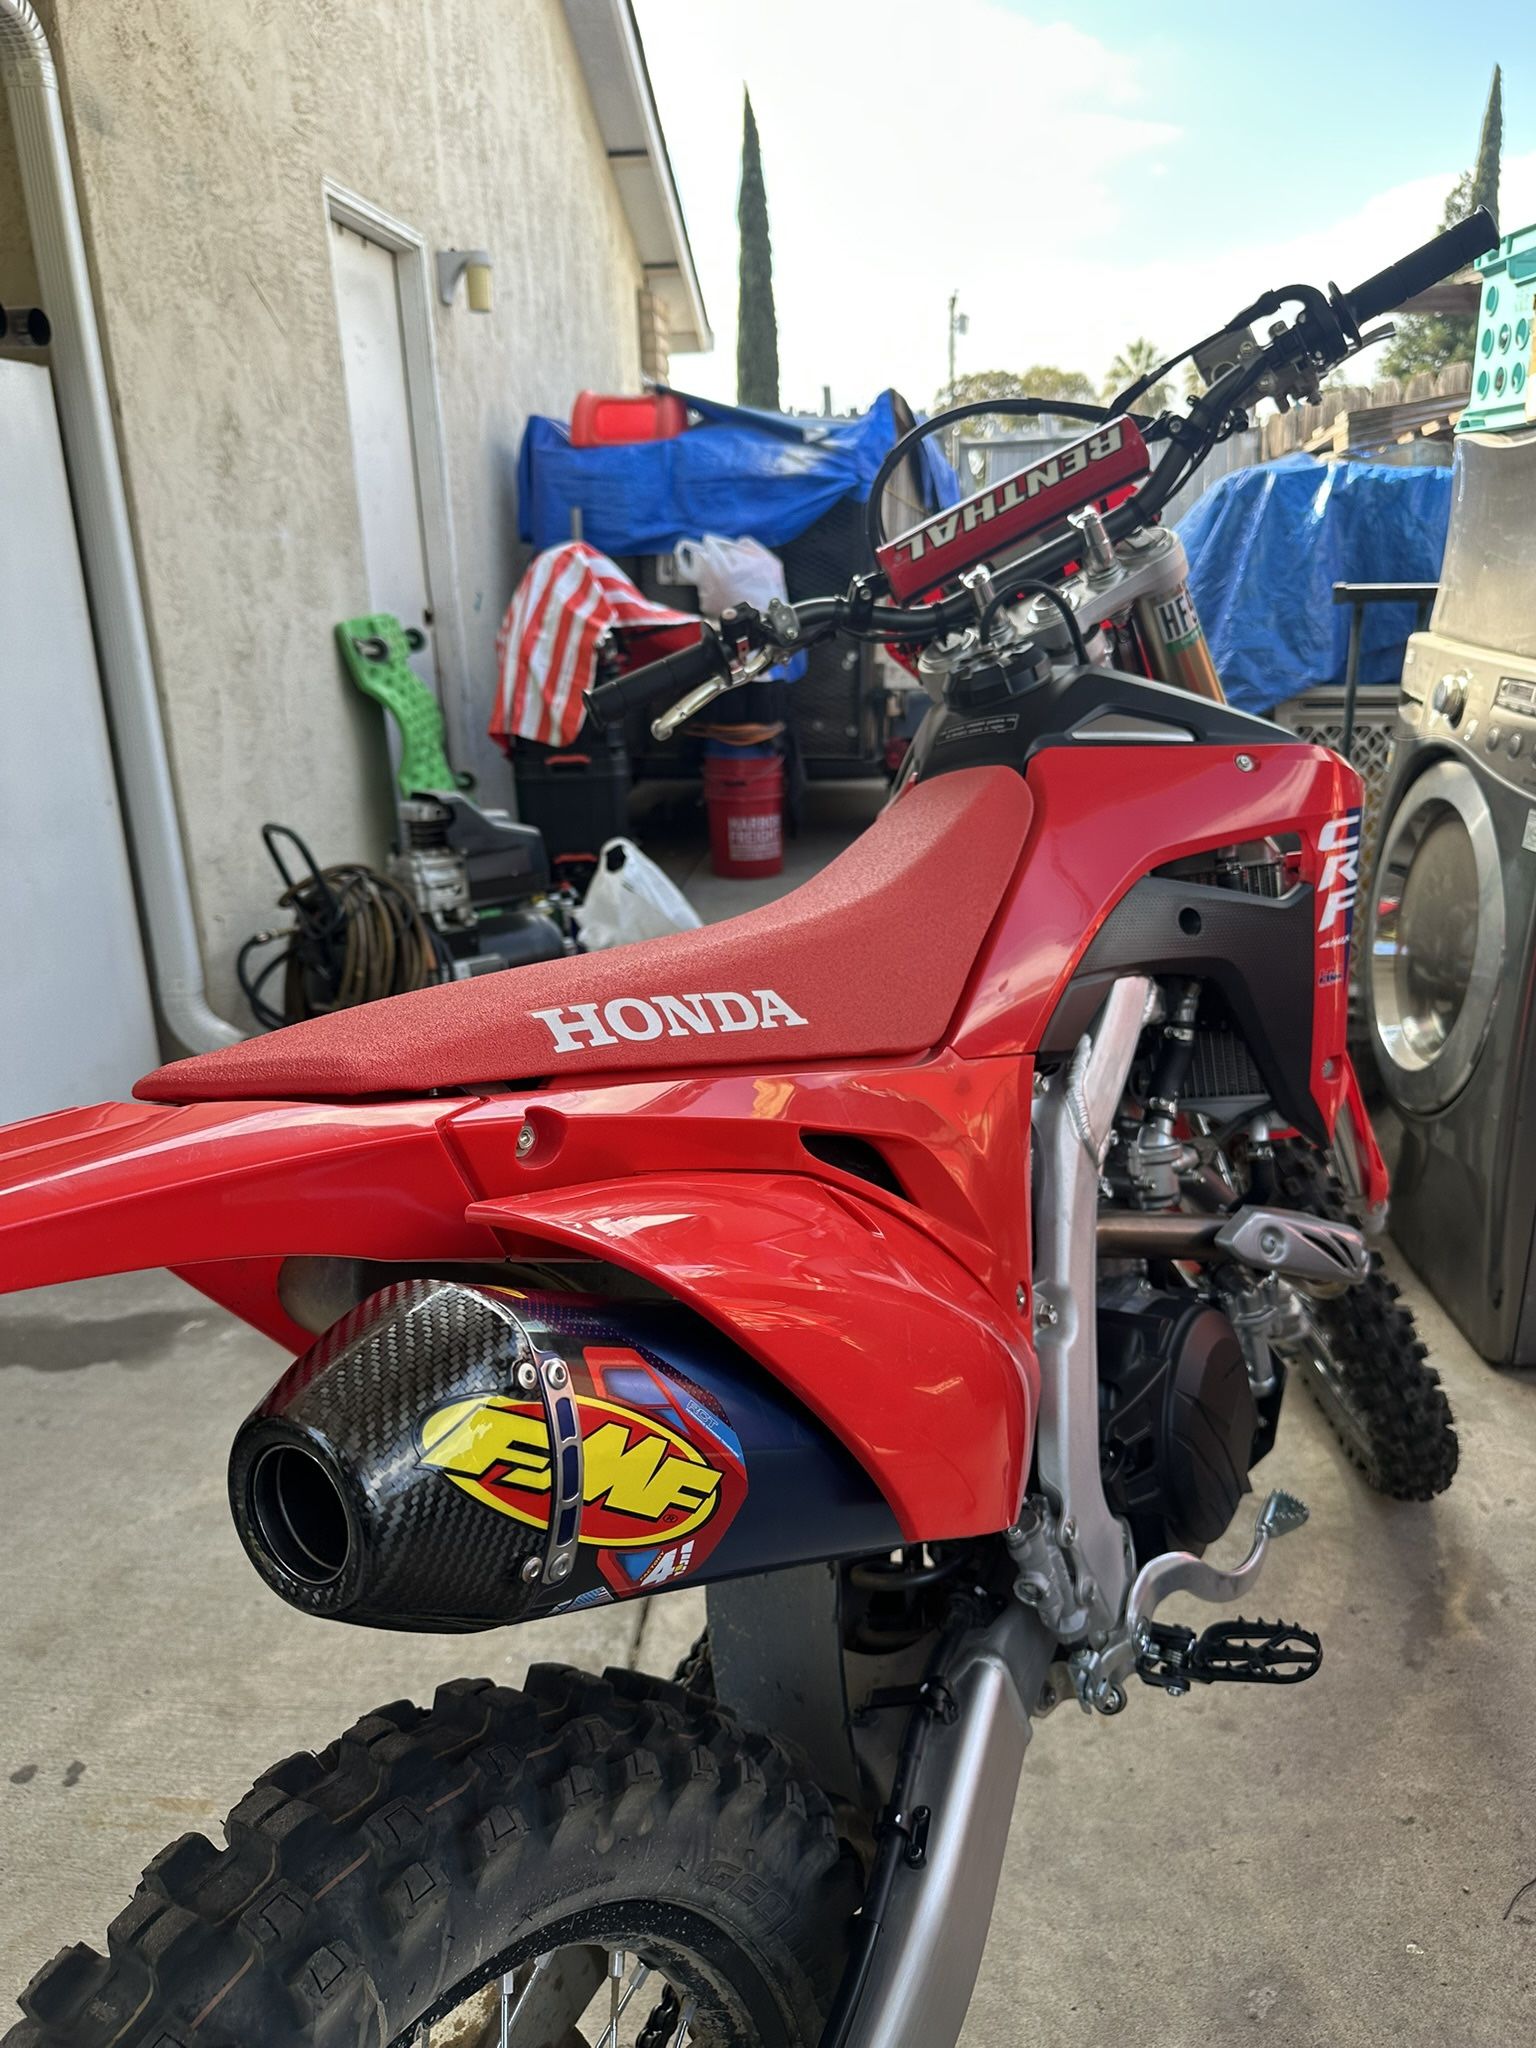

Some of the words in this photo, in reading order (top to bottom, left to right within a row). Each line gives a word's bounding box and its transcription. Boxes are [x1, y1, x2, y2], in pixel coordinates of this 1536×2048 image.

[896, 425, 1123, 562] RENTHAL
[1317, 814, 1360, 933] CRF
[531, 989, 809, 1053] HONDA
[420, 1405, 723, 1519] FMF
[686, 1399, 719, 1429] RCT
